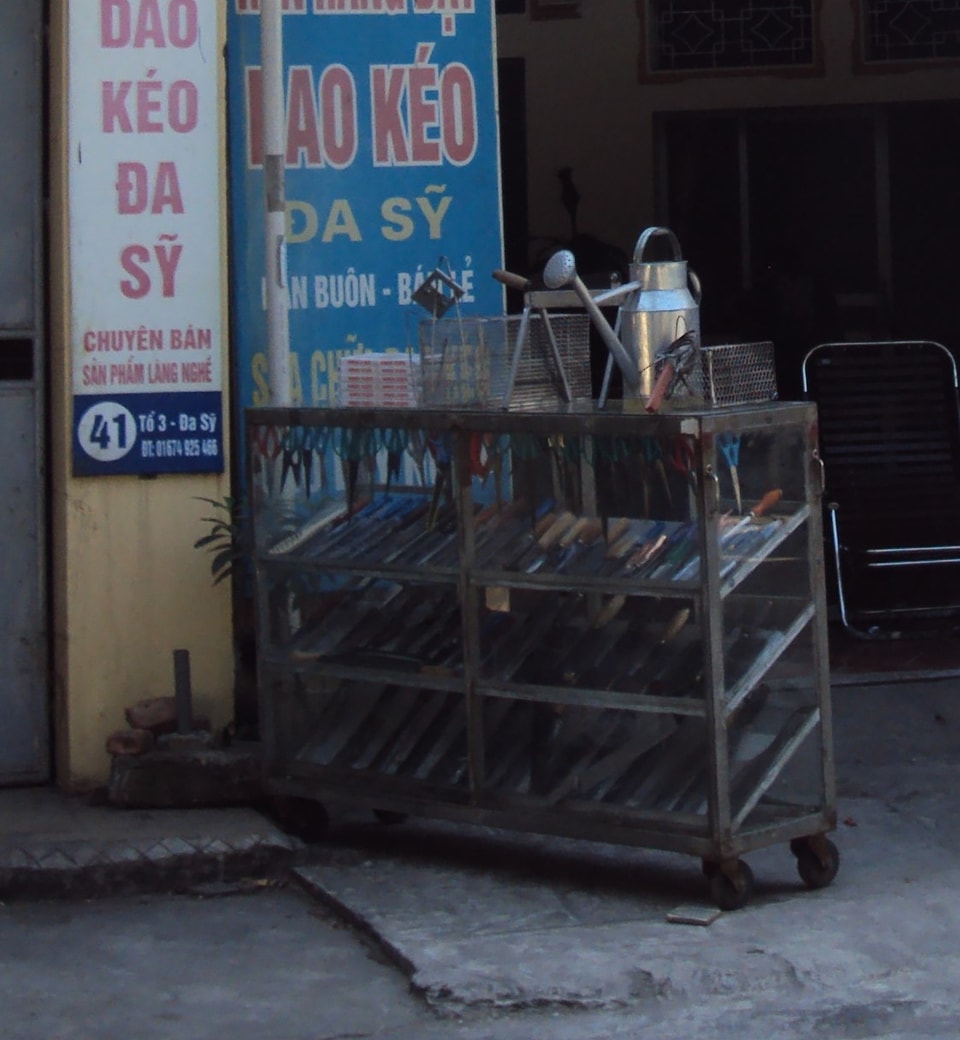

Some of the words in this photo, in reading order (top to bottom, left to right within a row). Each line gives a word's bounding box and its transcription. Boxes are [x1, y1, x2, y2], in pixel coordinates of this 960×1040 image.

[101, 69, 199, 134] KÉO
[369, 42, 478, 167] KÉO
[115, 161, 185, 215] ĐA
[283, 198, 363, 244] ĐA
[380, 183, 453, 241] SỸ
[119, 233, 184, 300] SỸ
[314, 266, 376, 309] BUÔN
[83, 325, 163, 353] CHUYÊN
[89, 413, 127, 450] 41
[157, 413, 167, 432] 3
